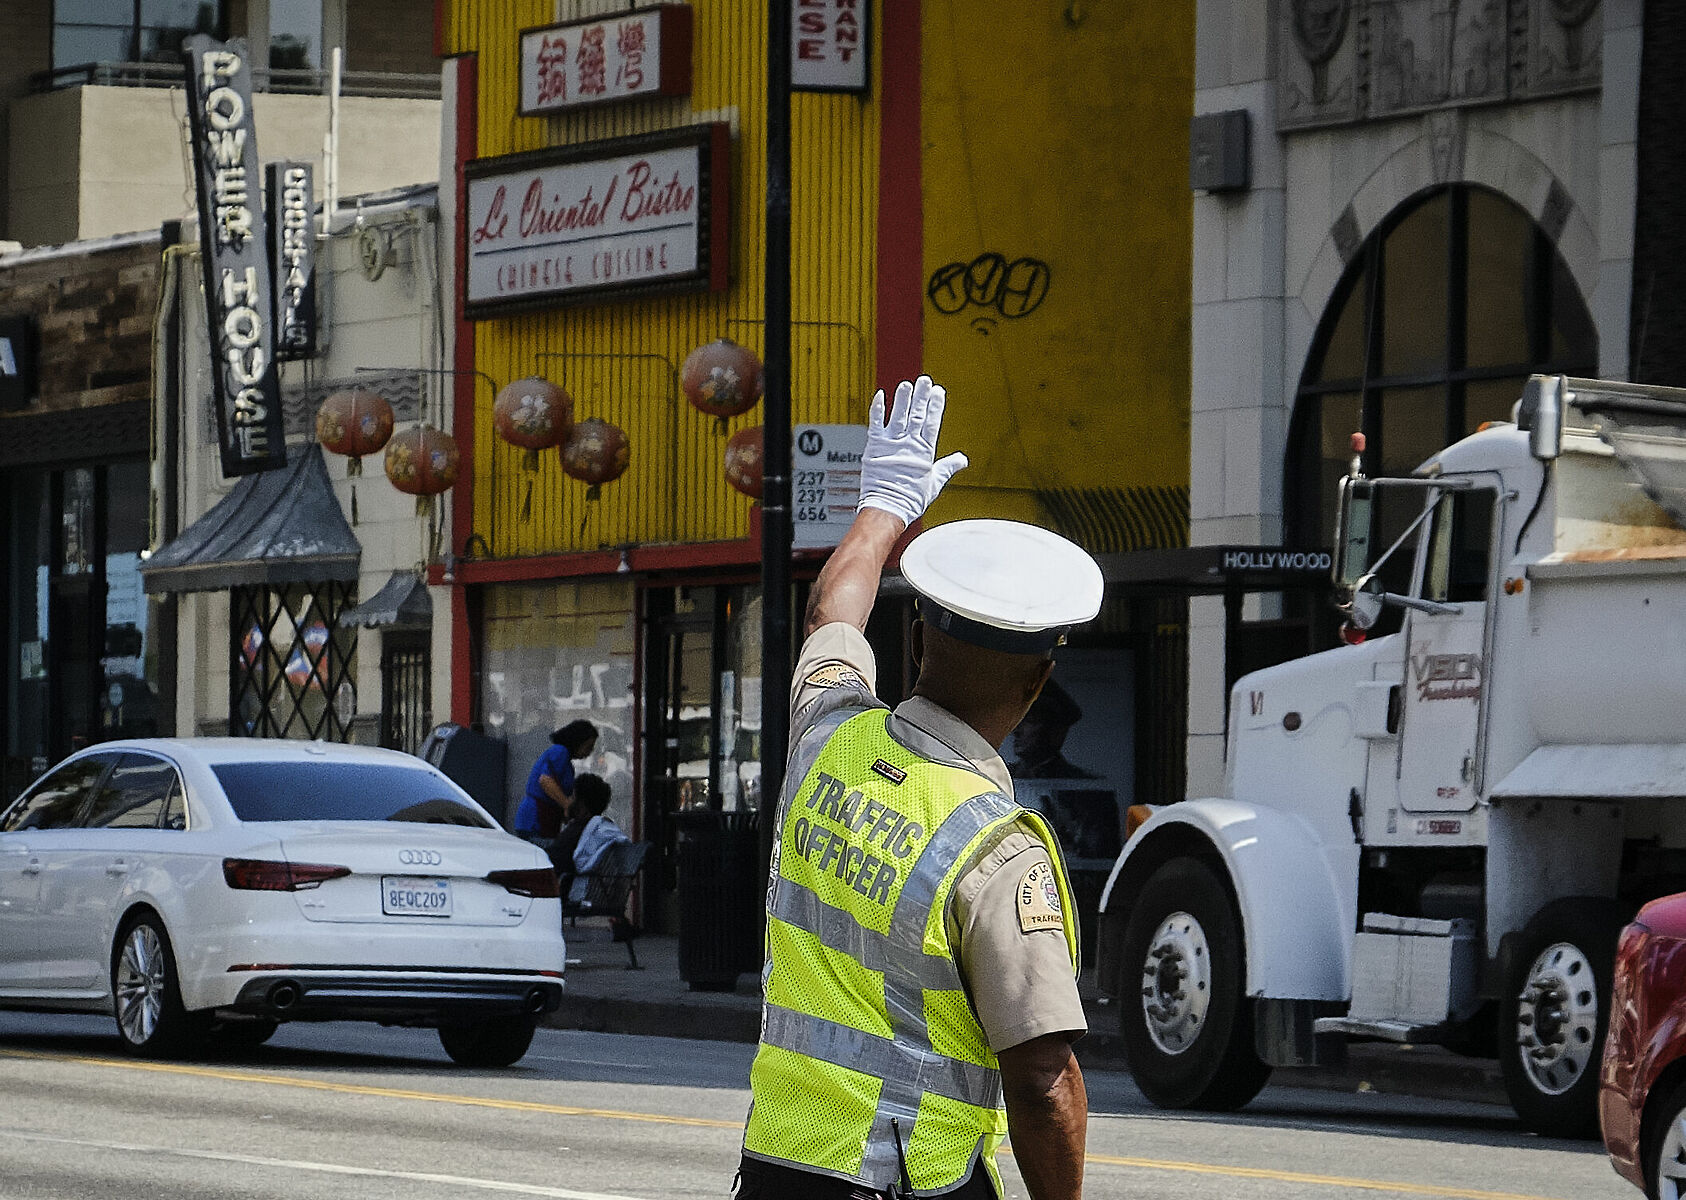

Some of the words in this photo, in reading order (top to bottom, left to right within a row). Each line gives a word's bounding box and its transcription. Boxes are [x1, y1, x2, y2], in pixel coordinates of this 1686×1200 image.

[203, 51, 252, 239] POWER
[473, 185, 508, 245] Le
[519, 176, 619, 238] Oriental
[620, 160, 695, 222] Bistro
[281, 167, 308, 346] COCKTAILS
[497, 256, 573, 291] CHINESE
[592, 242, 667, 279] CUISINE
[222, 266, 269, 458] HOUSE
[798, 471, 826, 485] 237
[798, 489, 826, 503] 237
[798, 507, 827, 521] 656
[1224, 551, 1332, 570] HOLLYWOOD
[806, 771, 923, 858] TRAFFIC
[794, 817, 897, 906] OFFICER
[1022, 883, 1033, 905] CITY
[1029, 870, 1039, 881] OF
